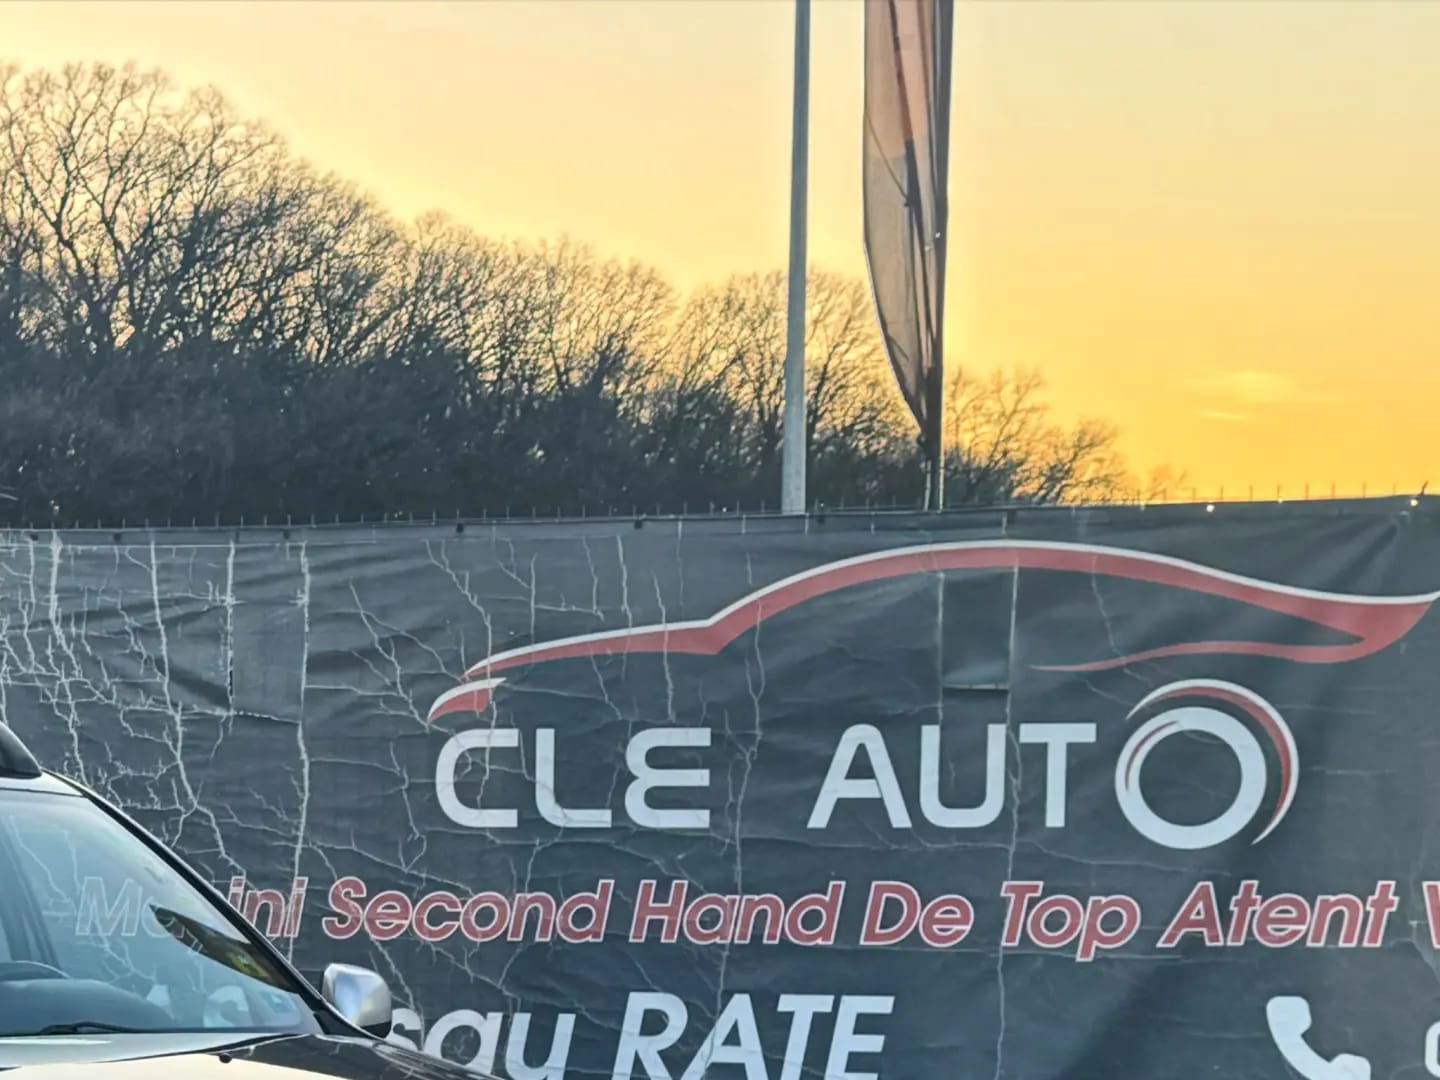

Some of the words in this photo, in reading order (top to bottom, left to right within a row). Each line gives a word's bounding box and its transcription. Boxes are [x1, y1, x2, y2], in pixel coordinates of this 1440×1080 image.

[435, 727, 711, 829] CLE
[807, 706, 1268, 850] AUTO
[322, 876, 614, 942] Second
[629, 880, 846, 946] Hand
[860, 881, 974, 949] De
[1001, 881, 1141, 962] Top
[1157, 880, 1399, 949] Atent
